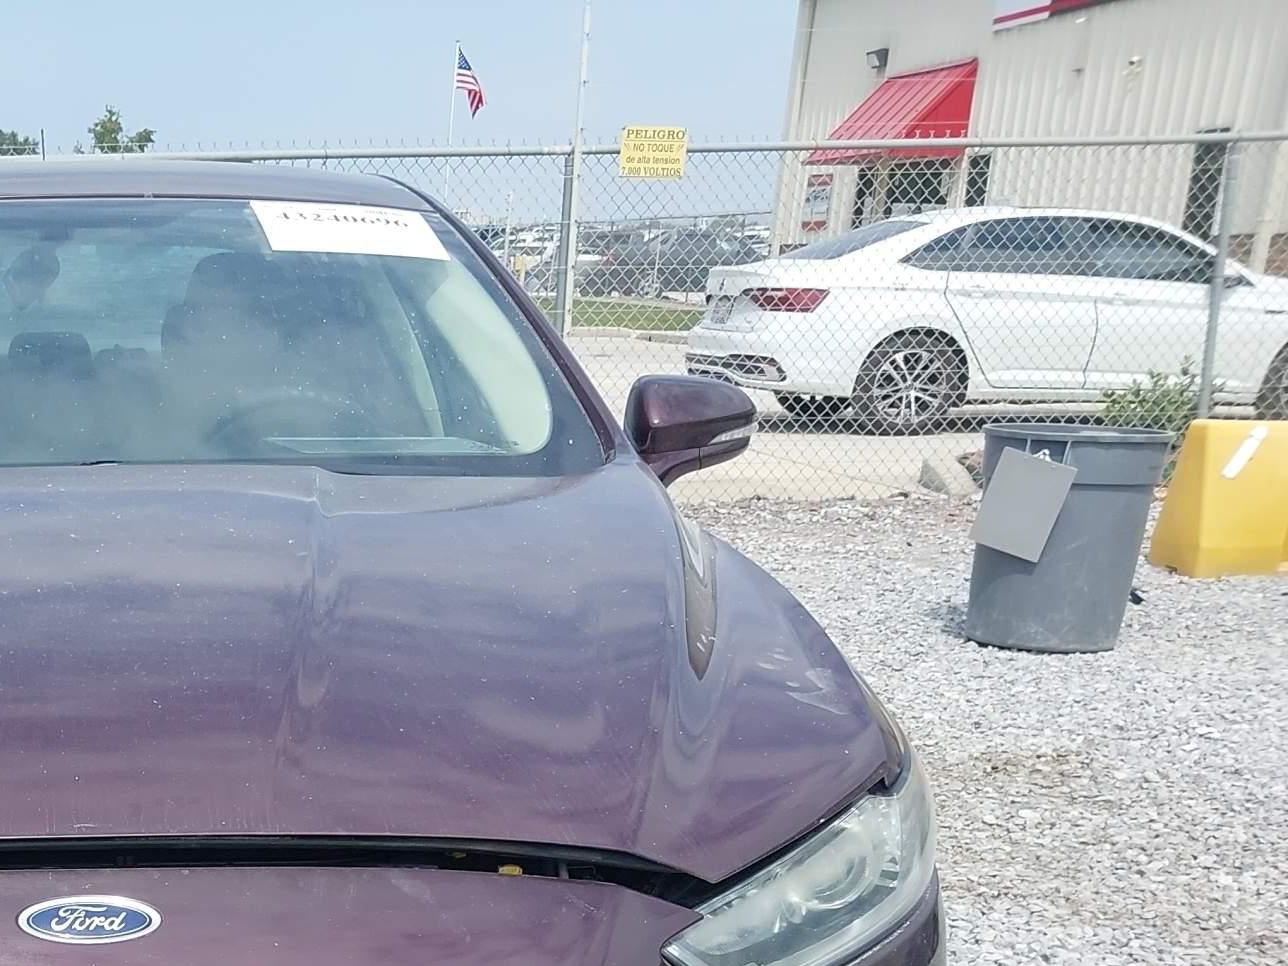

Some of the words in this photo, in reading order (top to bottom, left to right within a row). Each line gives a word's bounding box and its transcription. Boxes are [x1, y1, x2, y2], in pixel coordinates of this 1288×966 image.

[626, 129, 685, 140] PELIGRO
[633, 143, 645, 152] NO
[647, 143, 675, 153] TOQUE
[625, 155, 636, 164] de
[637, 155, 650, 165] alta
[643, 167, 681, 176] VOLTIOS
[50, 906, 127, 931] Ford
